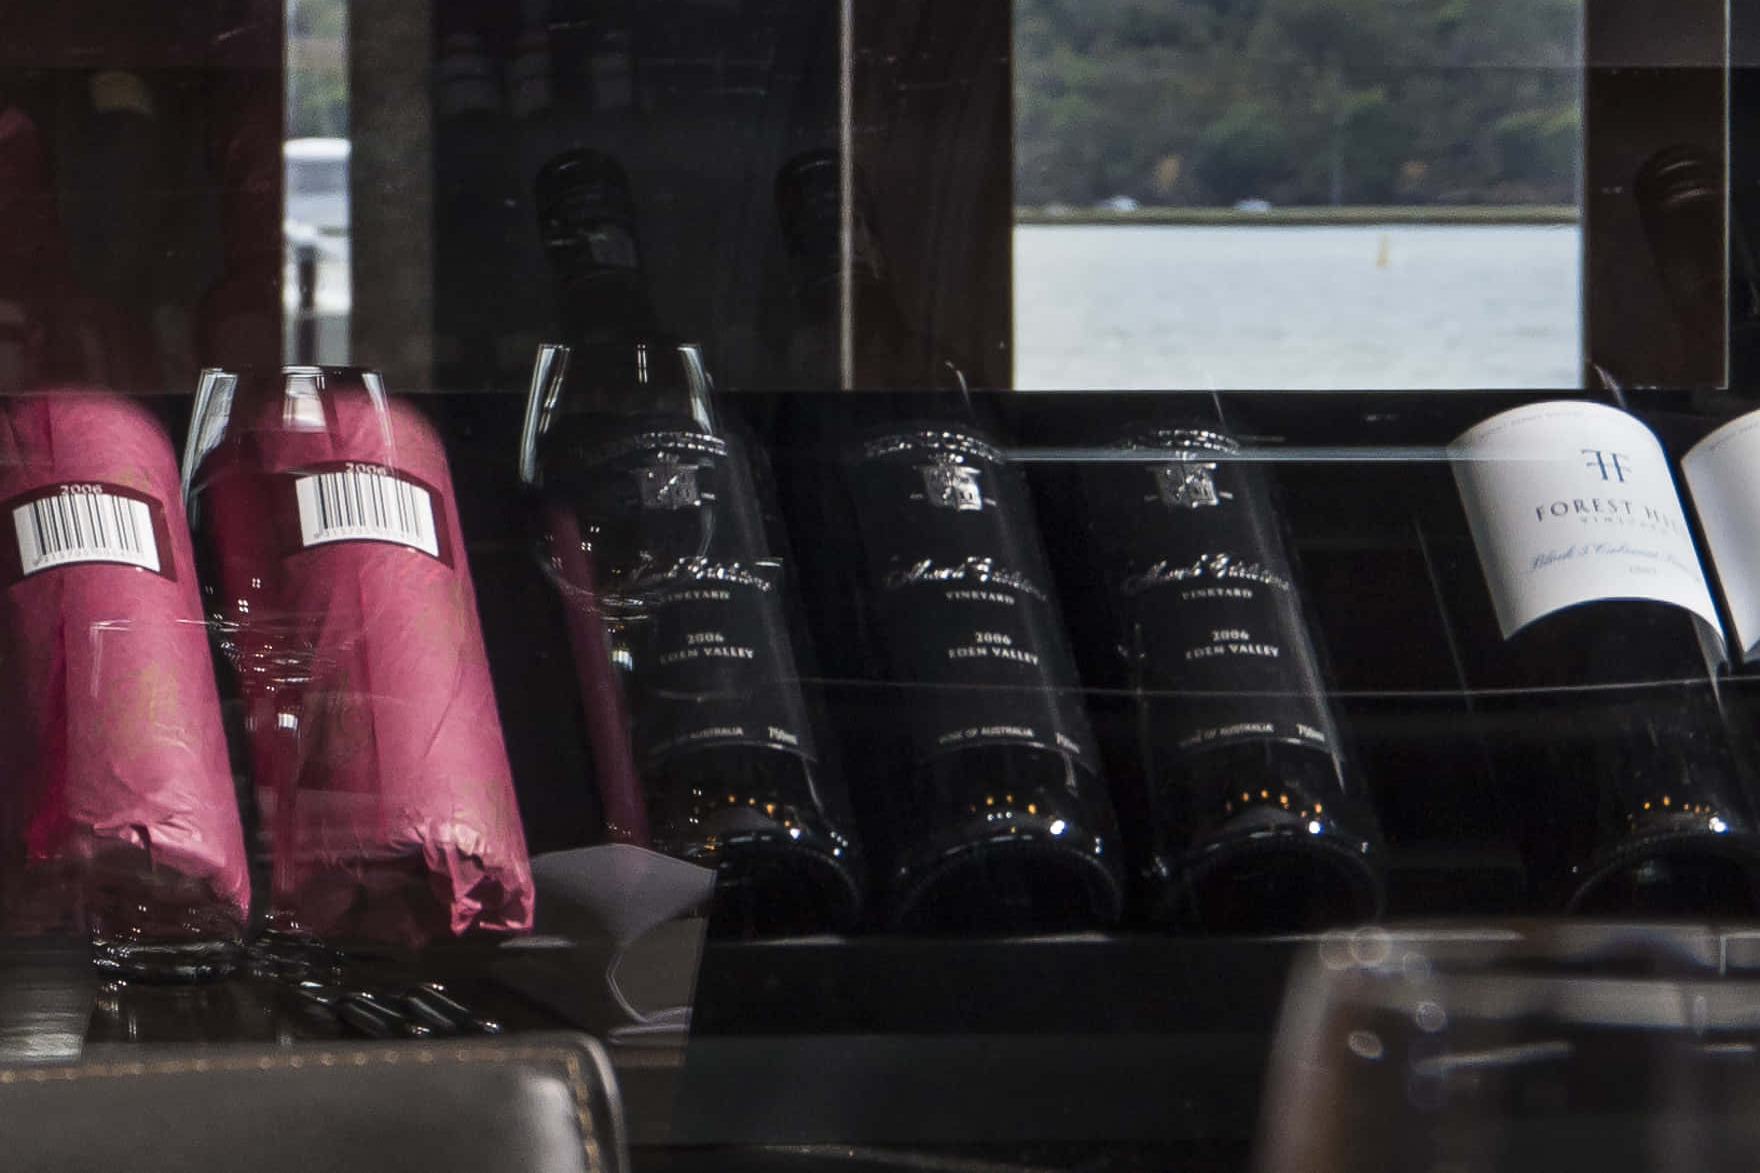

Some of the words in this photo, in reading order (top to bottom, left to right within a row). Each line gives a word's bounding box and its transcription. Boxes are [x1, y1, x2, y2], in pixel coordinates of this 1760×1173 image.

[60, 484, 103, 495] 2006
[1535, 498, 1633, 522] FOREST
[945, 590, 1015, 606] VINEYARD
[1182, 587, 1253, 600] VINEYARD
[703, 646, 755, 659] VALLEY
[948, 647, 988, 659] EDEN
[991, 646, 1039, 666] VALLEY
[1185, 645, 1225, 660] EDEN
[1228, 643, 1280, 658] VALLEY
[980, 726, 1036, 738] AUSTRALIA
